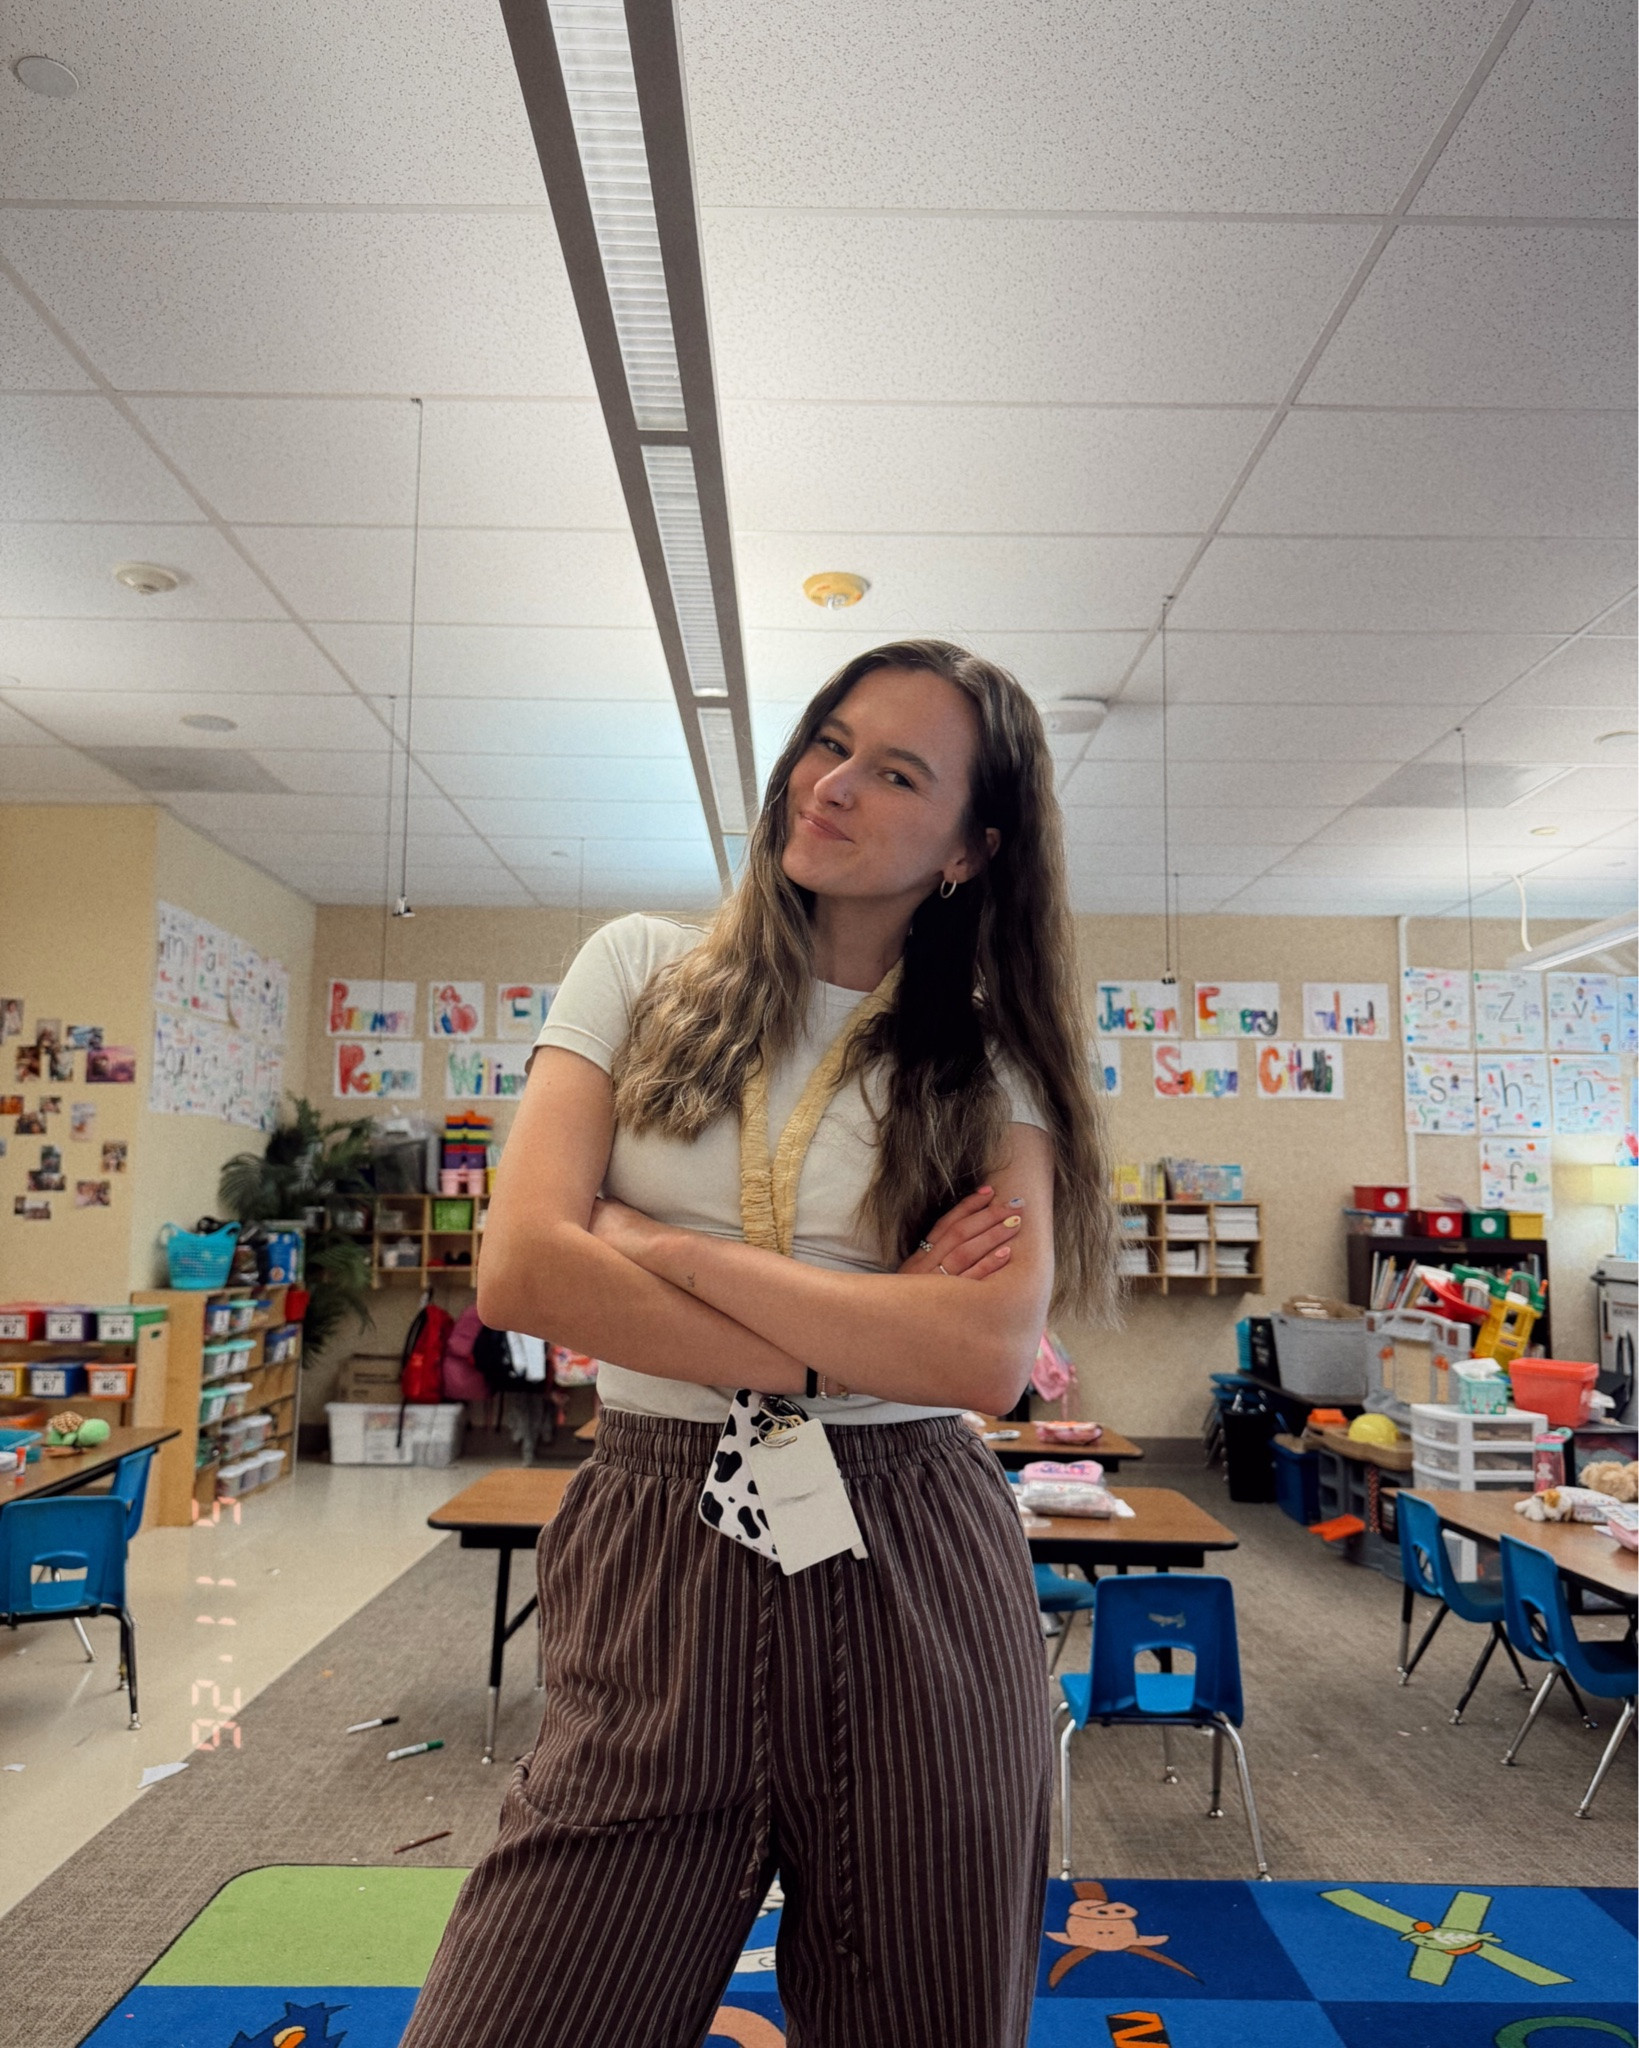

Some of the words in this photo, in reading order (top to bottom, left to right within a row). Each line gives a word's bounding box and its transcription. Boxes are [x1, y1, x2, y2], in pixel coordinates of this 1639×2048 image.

[1098, 986, 1178, 1033] Jackson
[1197, 986, 1279, 1037] Emery
[1500, 1069, 1524, 1108] h
[1573, 1077, 1595, 1103] n
[1506, 1160, 1524, 1191] f
